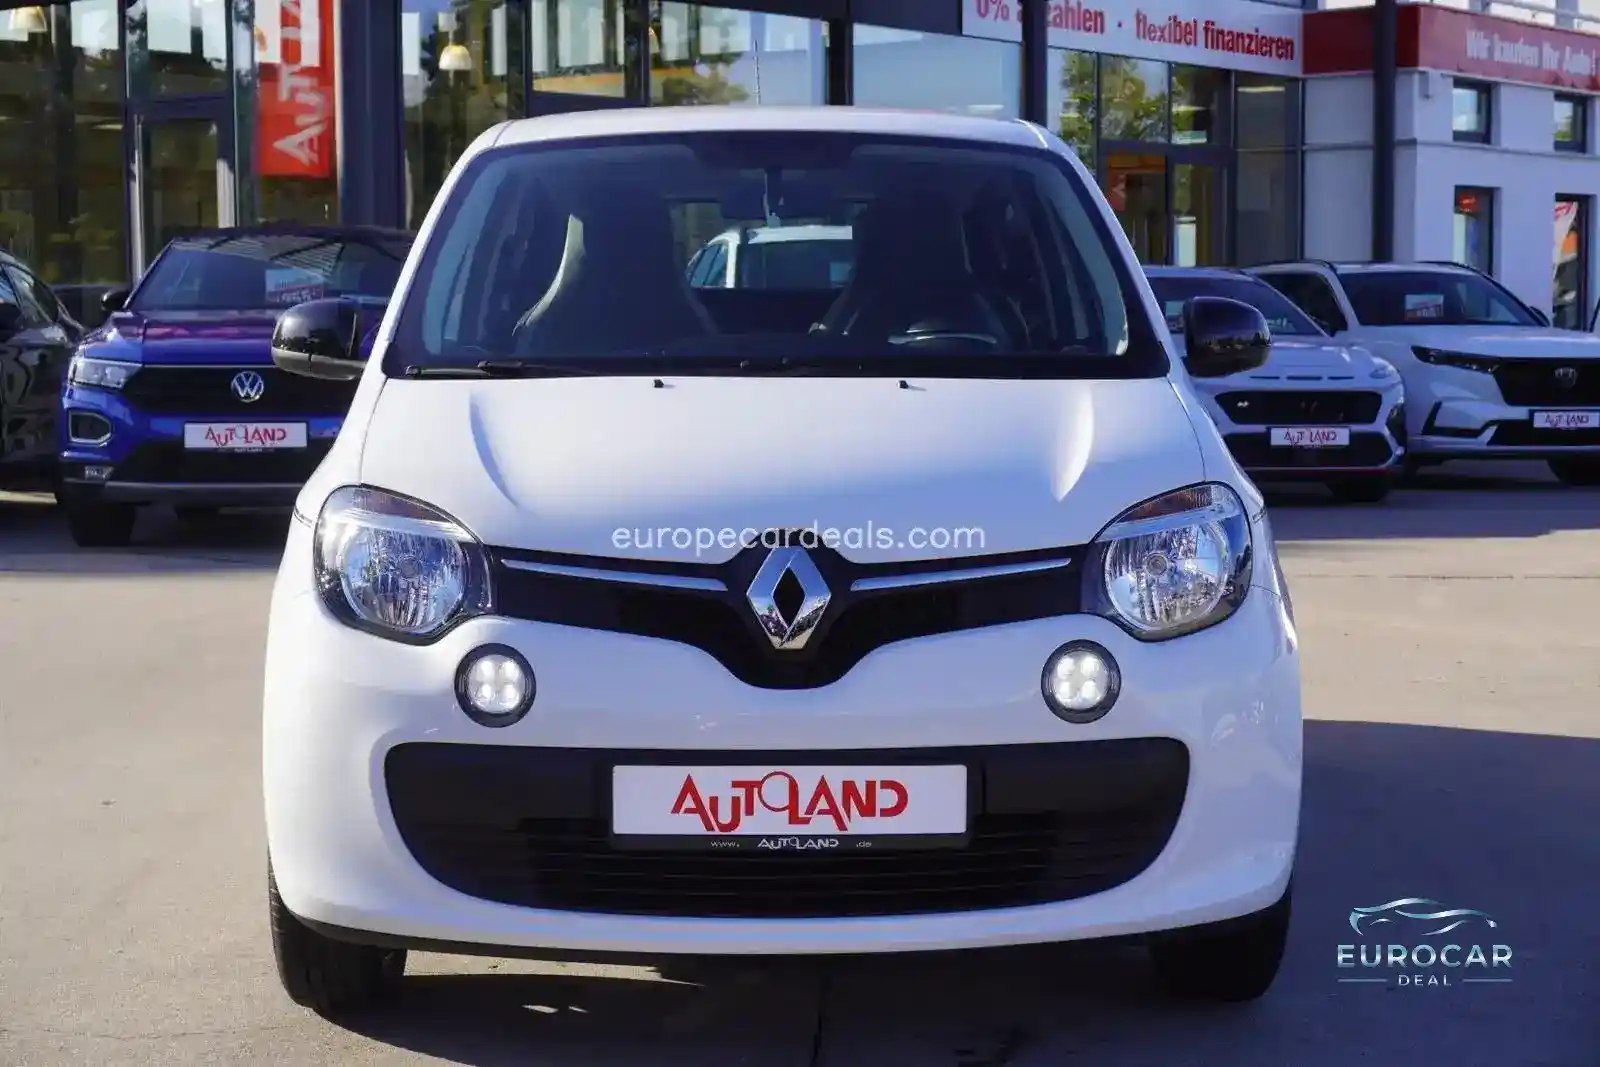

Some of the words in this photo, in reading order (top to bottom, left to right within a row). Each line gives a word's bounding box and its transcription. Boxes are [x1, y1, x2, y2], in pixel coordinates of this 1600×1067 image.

[1016, 0, 1105, 34] azahlen
[1135, 8, 1198, 47] flexibel
[1202, 20, 1294, 60] finanzieren
[1493, 33, 1539, 68] kaufen
[670, 770, 909, 833] AUTOLAND
[710, 840, 740, 848] www.
[757, 835, 840, 850] AUTOLAND
